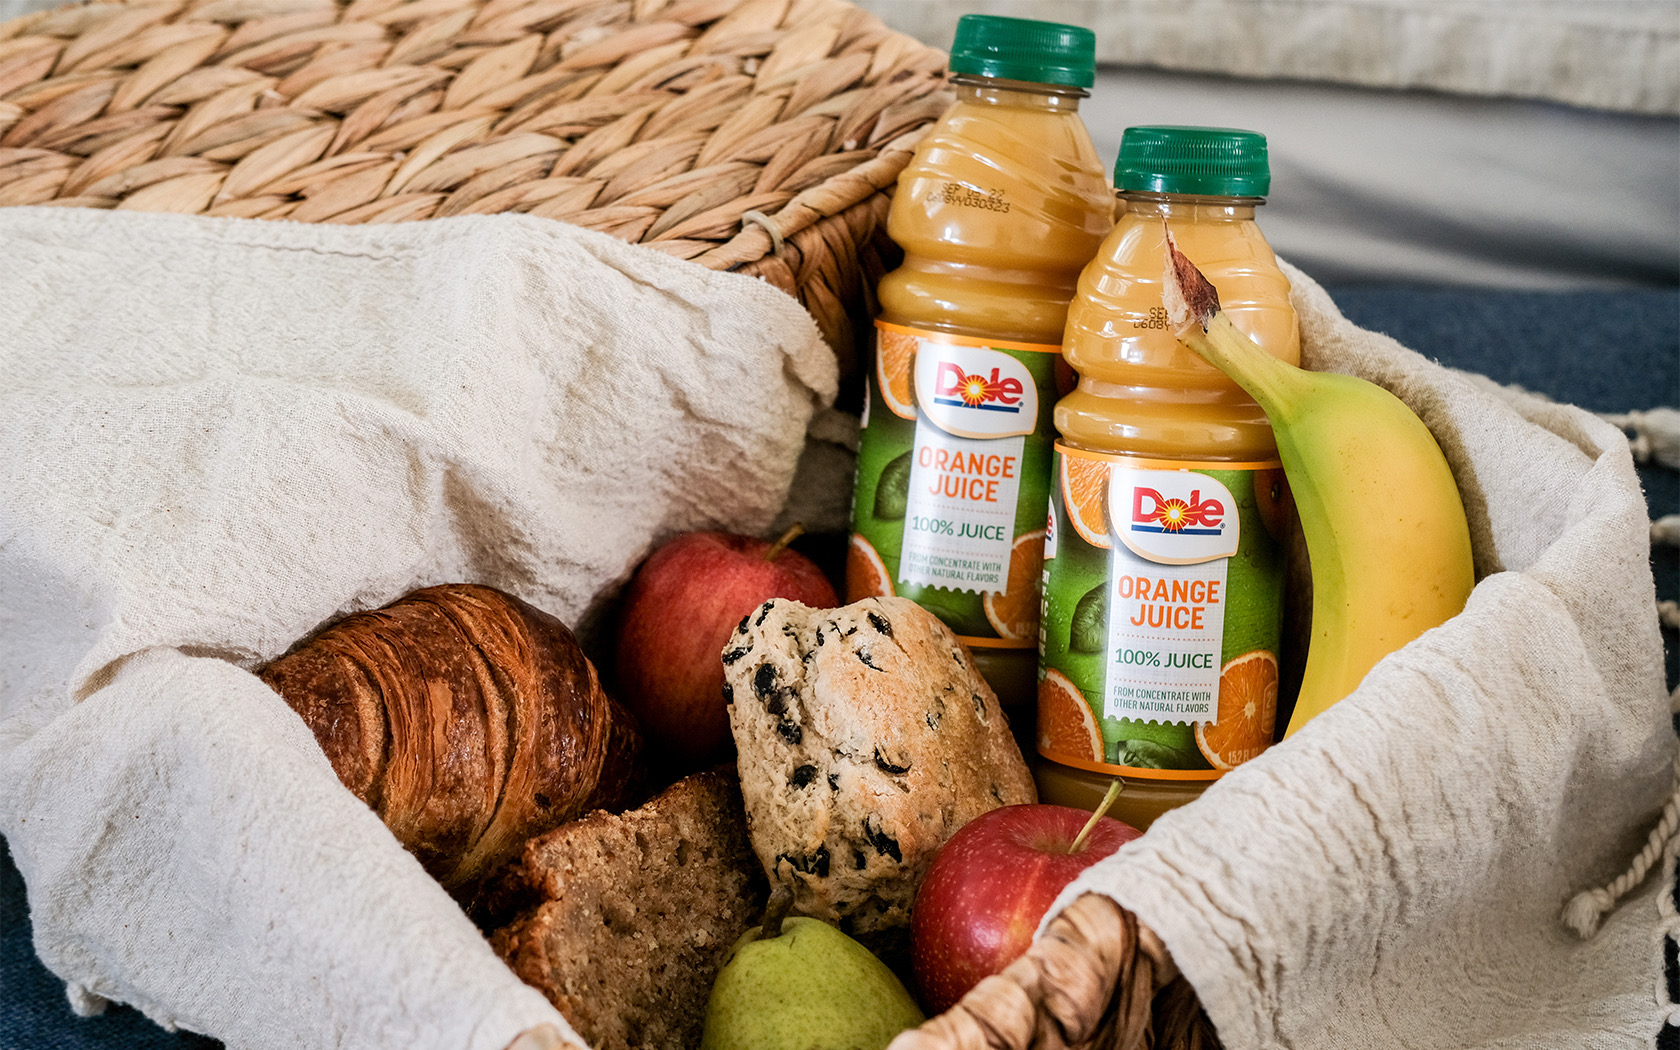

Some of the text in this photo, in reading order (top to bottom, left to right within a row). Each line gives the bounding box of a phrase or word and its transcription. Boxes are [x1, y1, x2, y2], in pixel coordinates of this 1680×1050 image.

[935, 360, 1024, 406] Dole
[919, 446, 1016, 479] ORANGE
[928, 474, 1000, 503] JUICE
[1132, 486, 1225, 531] Dole
[912, 515, 1006, 541] 100% JUICE
[908, 551, 1002, 573] FROM CONCENTRATE WITH
[908, 563, 999, 584] OTHER NATURAL FLAVORS
[1118, 574, 1221, 604] ORANGE
[1130, 603, 1205, 630] JUICE
[1115, 648, 1214, 669] 100% JUICE
[1113, 685, 1211, 701] FROM CONCENTRATE WITH
[1113, 698, 1209, 713] OTHER NATURAL FLAVORS
